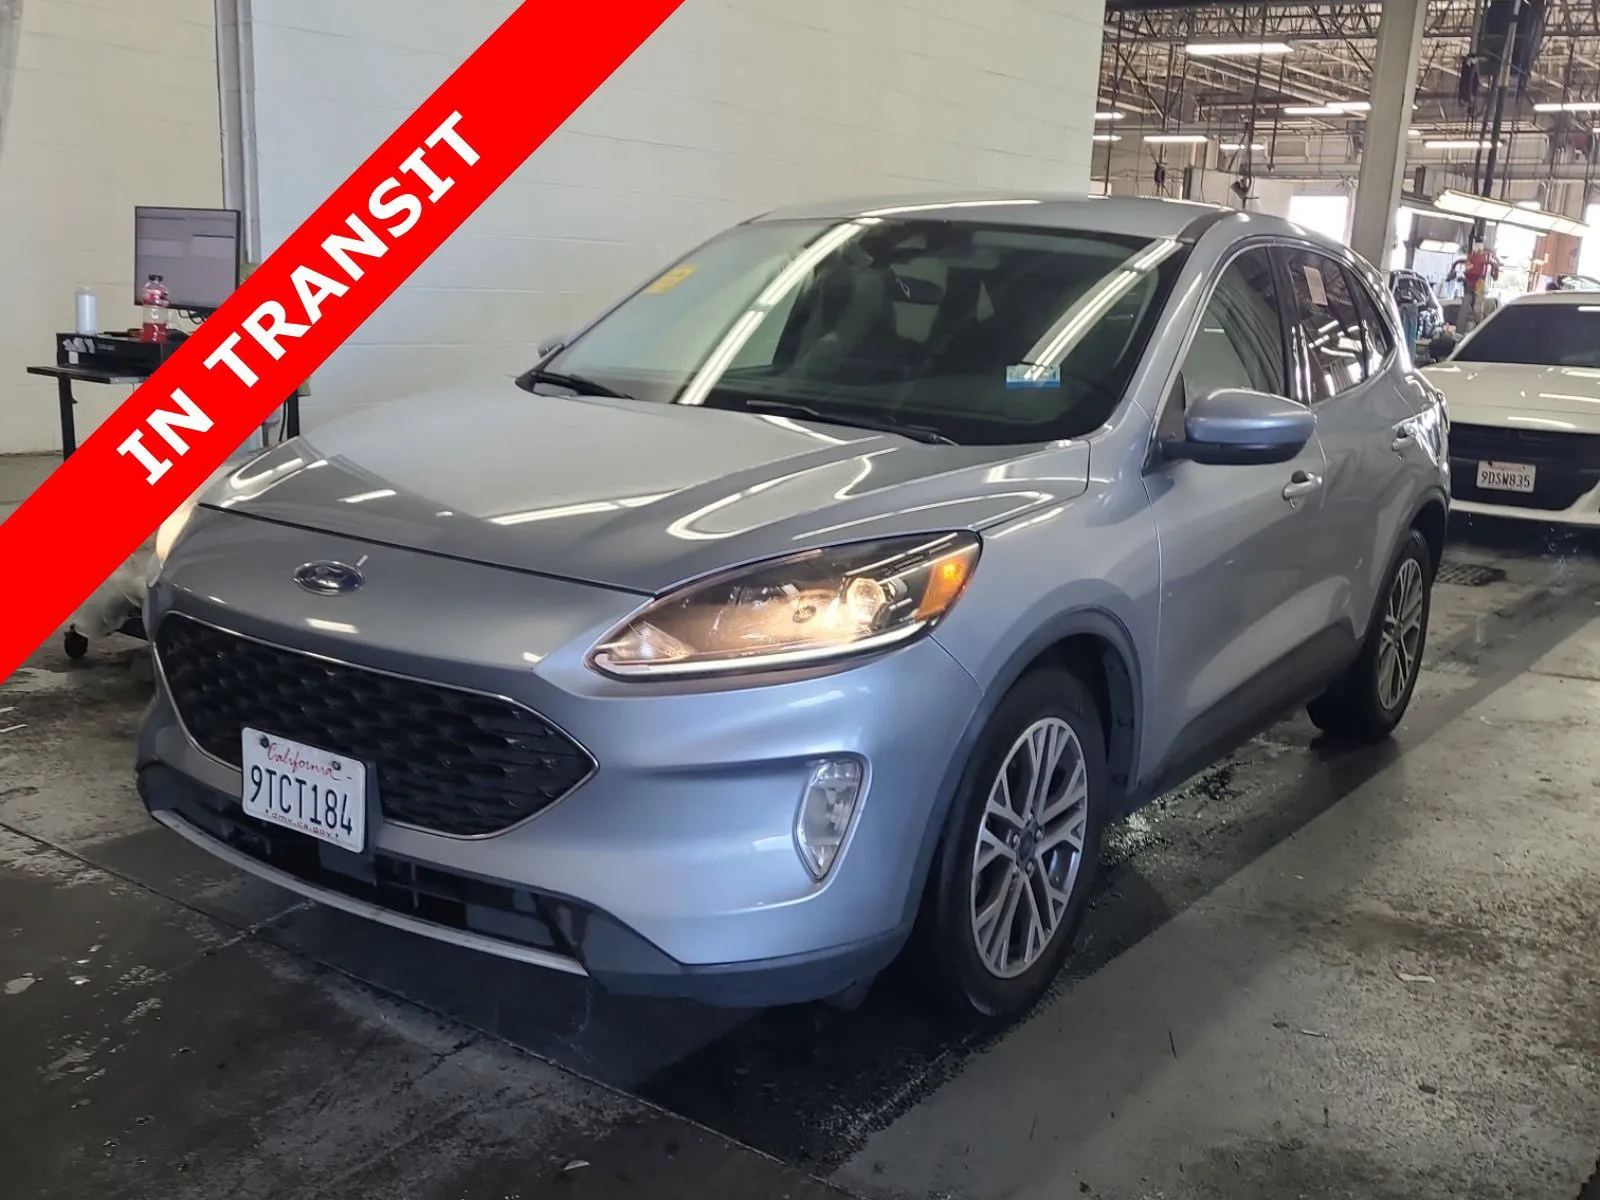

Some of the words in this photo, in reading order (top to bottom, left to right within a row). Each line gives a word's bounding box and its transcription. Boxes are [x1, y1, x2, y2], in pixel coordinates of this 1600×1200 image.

[1481, 470, 1531, 488] 9DSW835
[267, 742, 341, 781] California
[250, 764, 353, 836] 9TCT184
